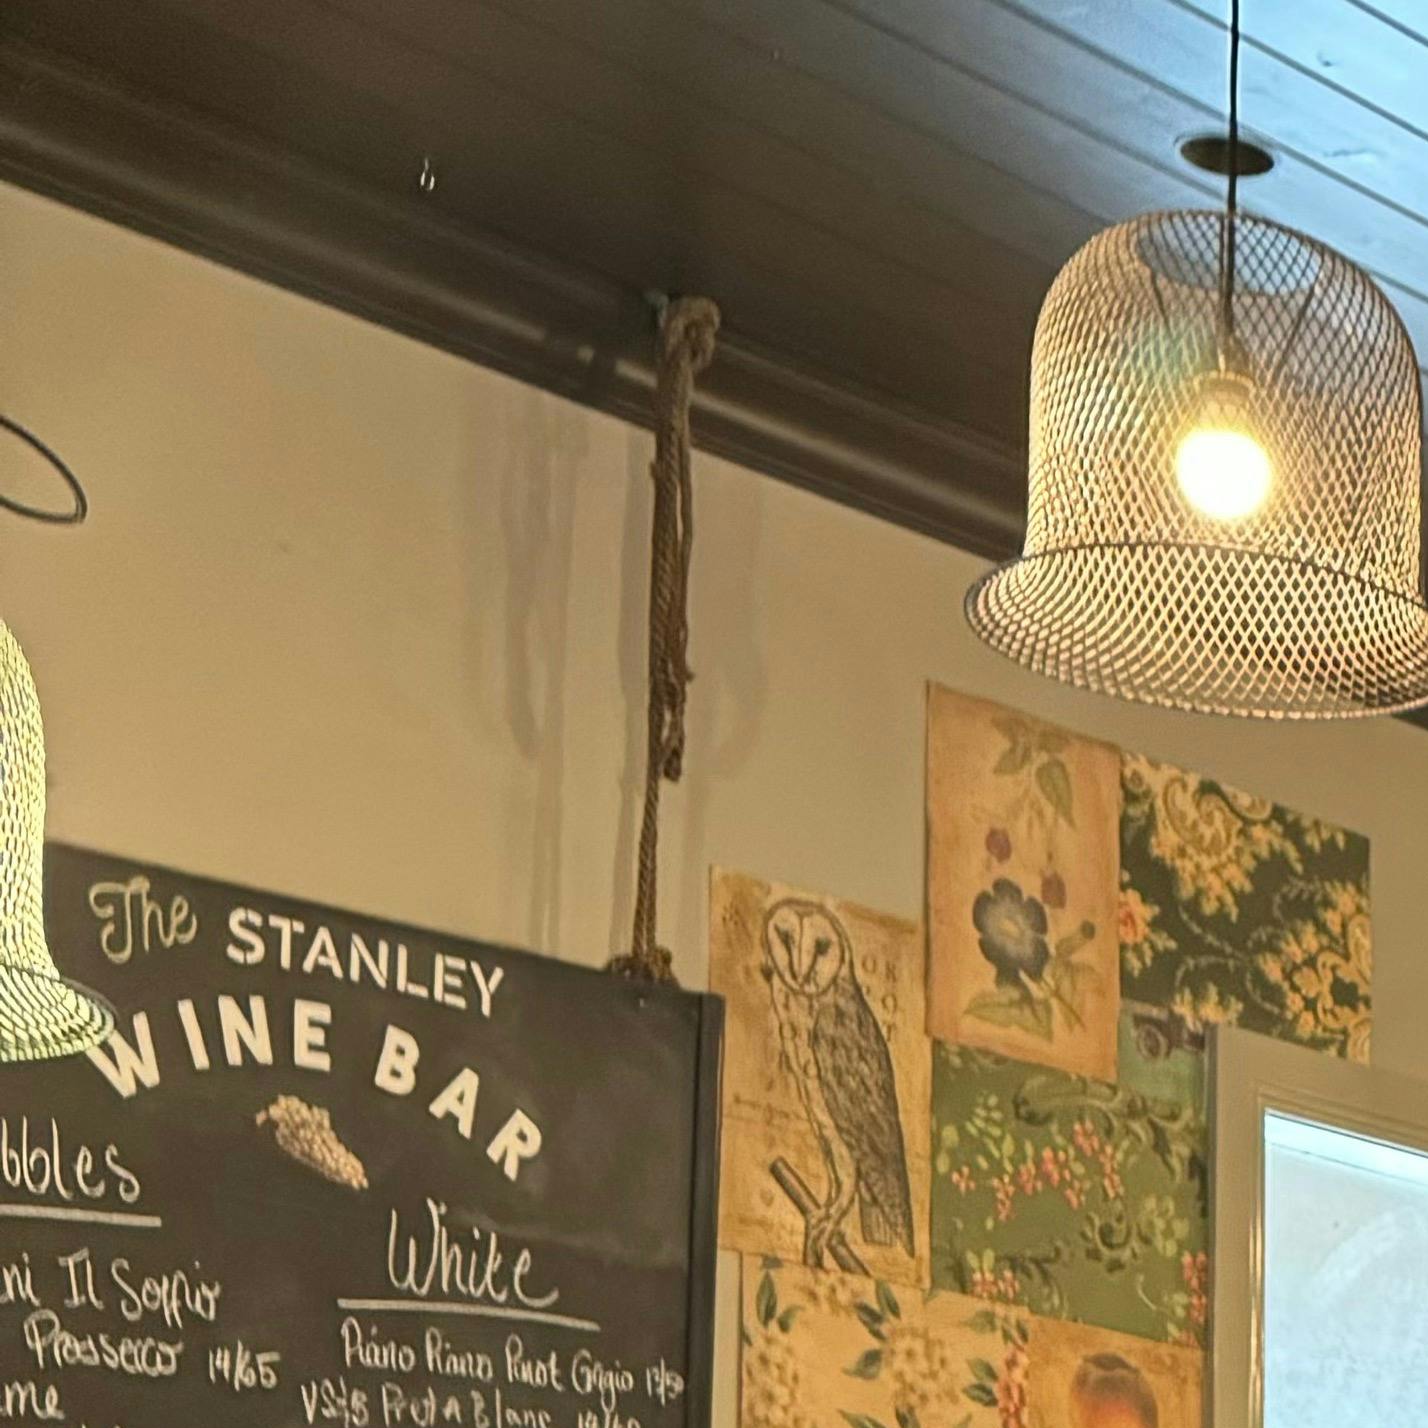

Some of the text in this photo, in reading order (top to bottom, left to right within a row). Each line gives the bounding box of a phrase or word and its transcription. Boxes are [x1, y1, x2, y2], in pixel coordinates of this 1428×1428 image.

[89, 874, 504, 1019] The STANLEY
[86, 994, 542, 1182] WINE BAR
[388, 1197, 560, 1308] White
